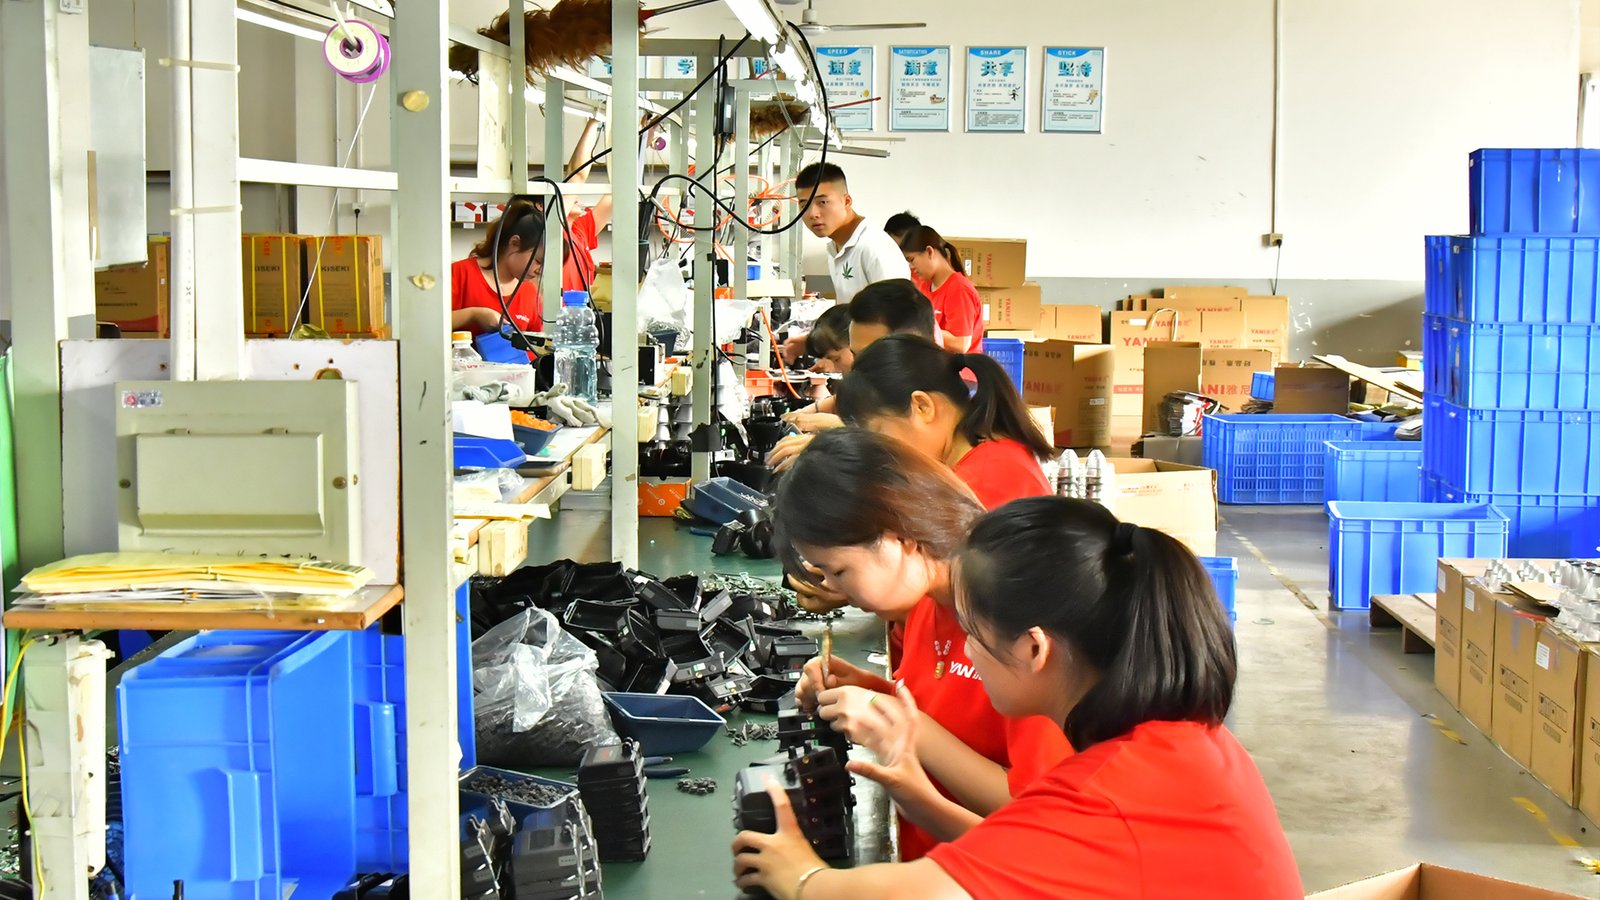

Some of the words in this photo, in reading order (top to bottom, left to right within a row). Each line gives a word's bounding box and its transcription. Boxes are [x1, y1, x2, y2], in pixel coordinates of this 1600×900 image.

[828, 60, 862, 76] 速度
[904, 60, 938, 76] 满意
[980, 61, 1015, 77] 共享
[1057, 61, 1092, 77] 坚持
